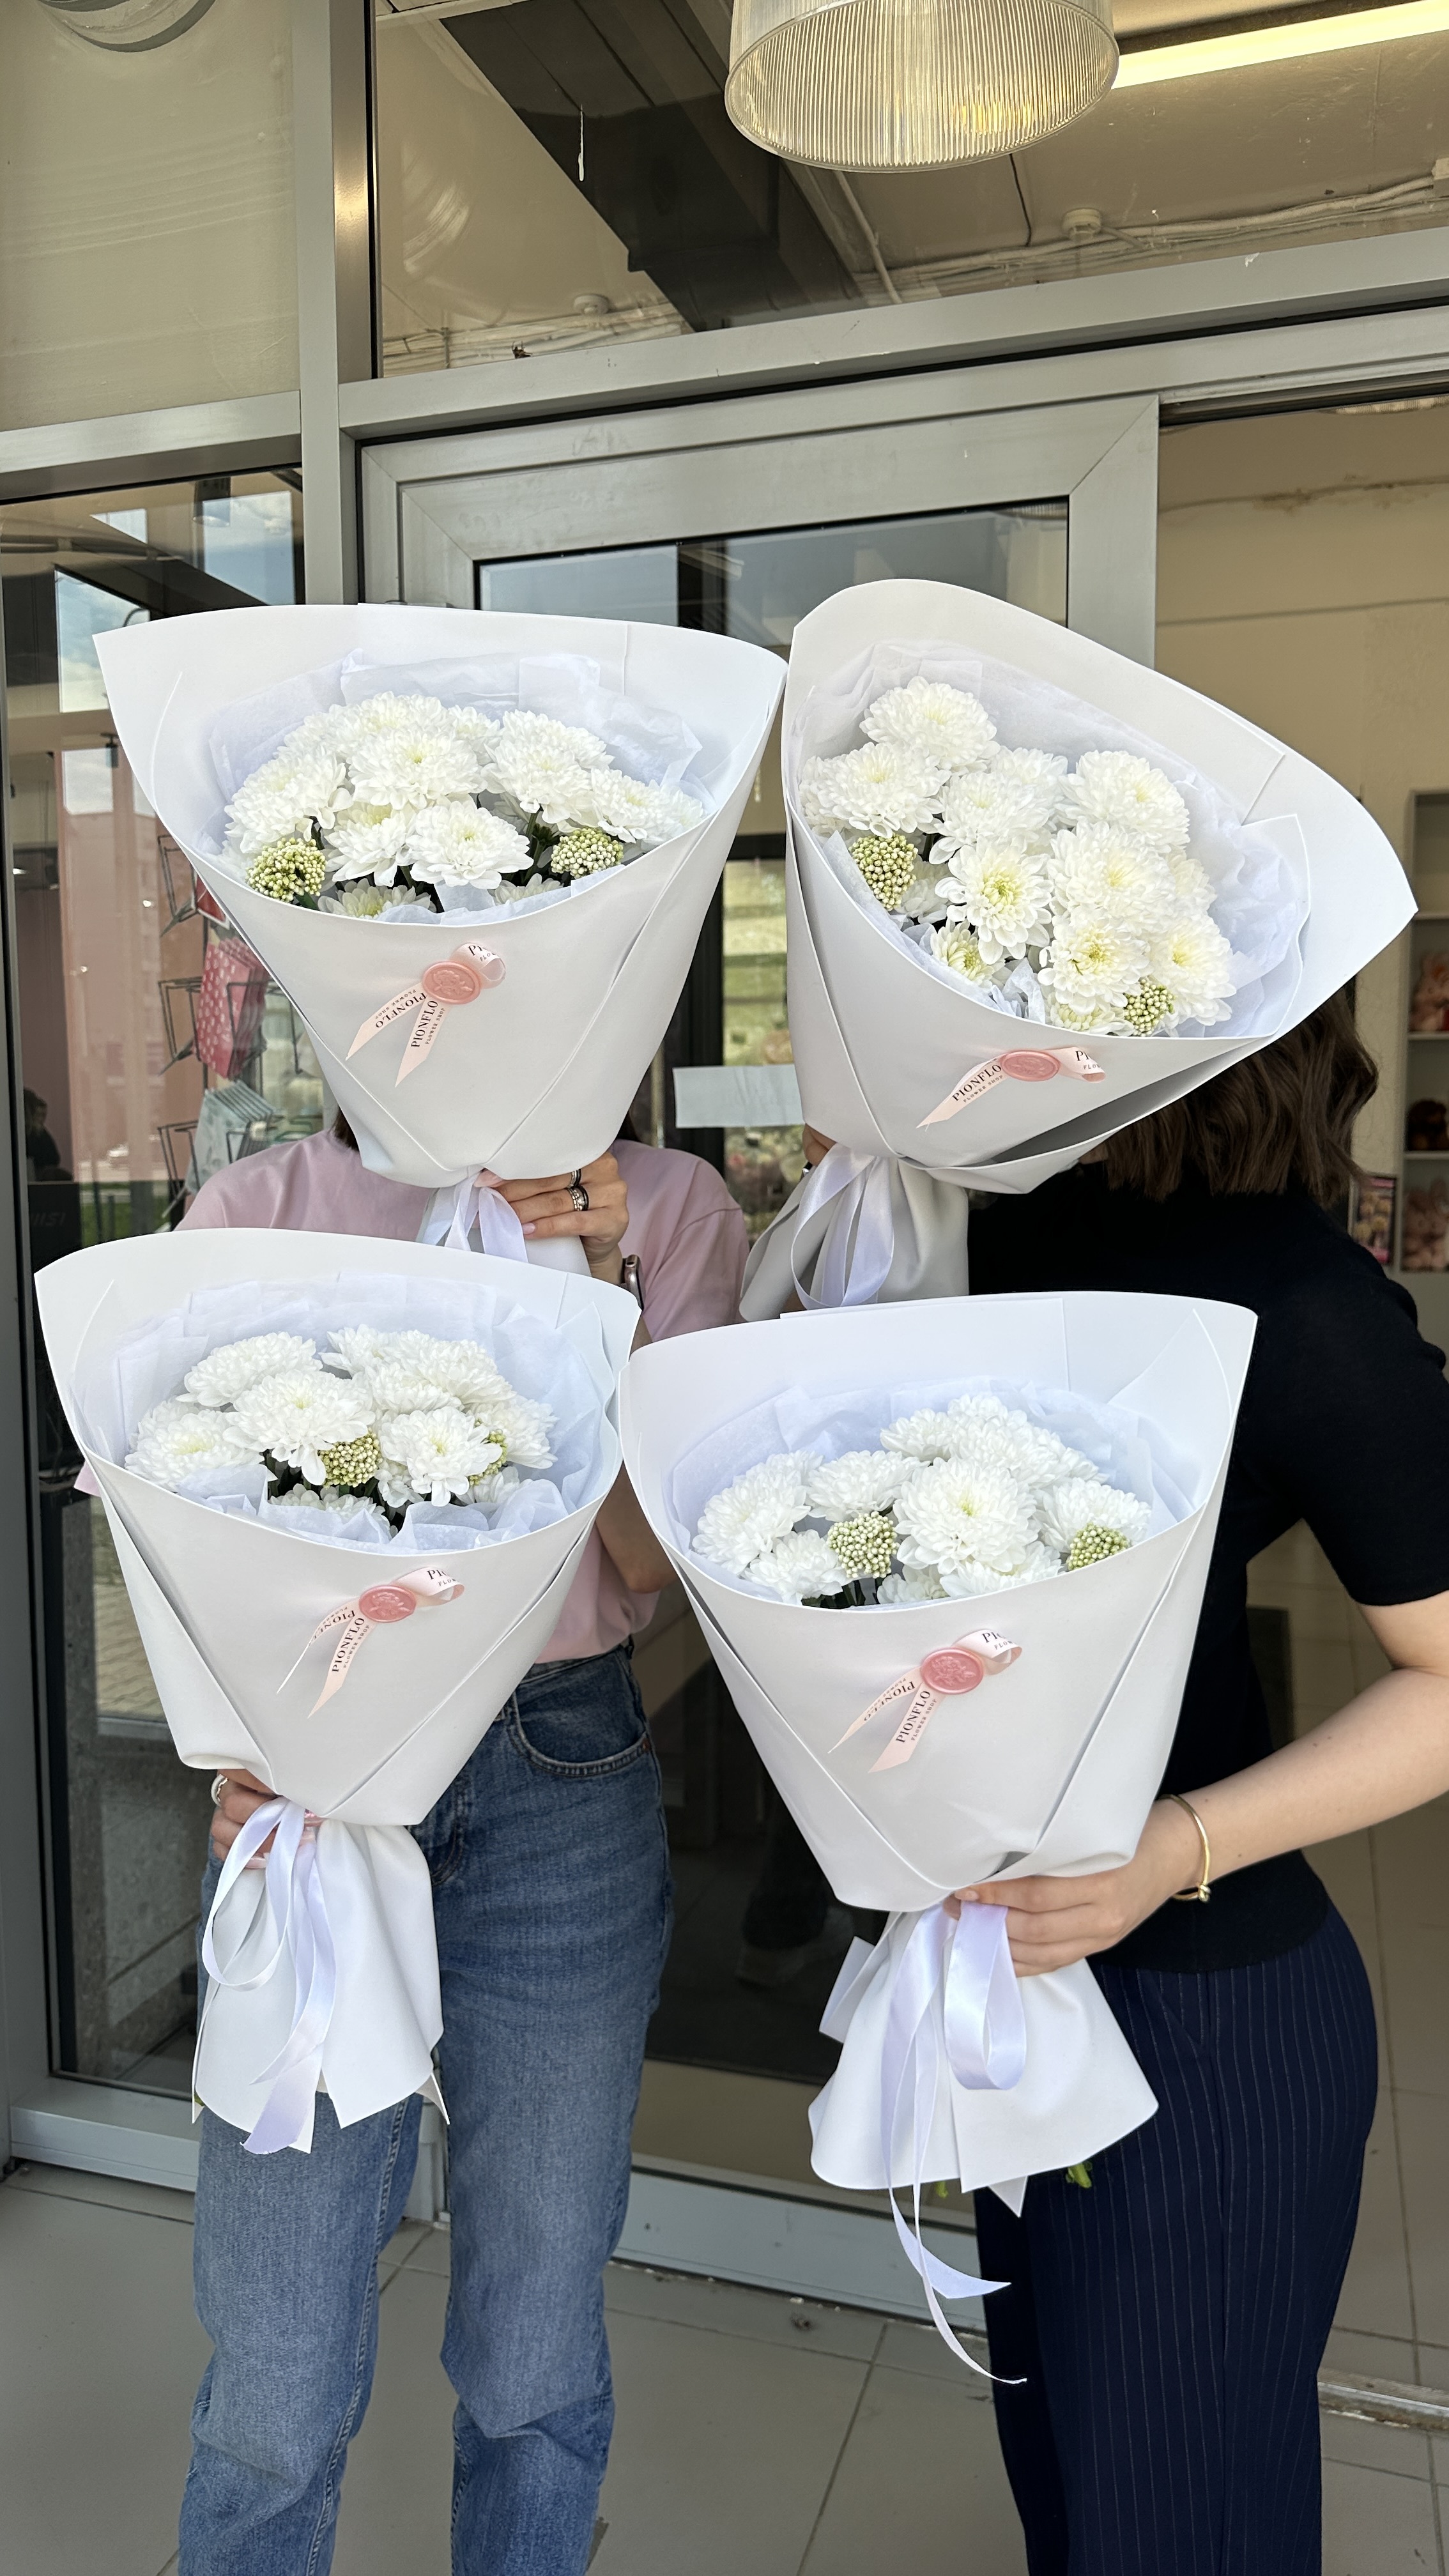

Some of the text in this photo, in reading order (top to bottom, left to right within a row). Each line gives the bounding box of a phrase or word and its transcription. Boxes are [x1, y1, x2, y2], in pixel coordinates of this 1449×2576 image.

[375, 992, 427, 1029] PIONFLO
[411, 1000, 438, 1048] PIONFLO
[425, 1008, 446, 1045] FLOWER SHOP
[952, 1064, 1002, 1102] PIONFLO
[963, 1086, 986, 1103] FLOWER
[332, 1618, 365, 1673] PIONFLO
[344, 1642, 358, 1669] FLOWER
[896, 1690, 931, 1743] PIONFLO
[910, 1698, 937, 1741] FLOWER SHOP
